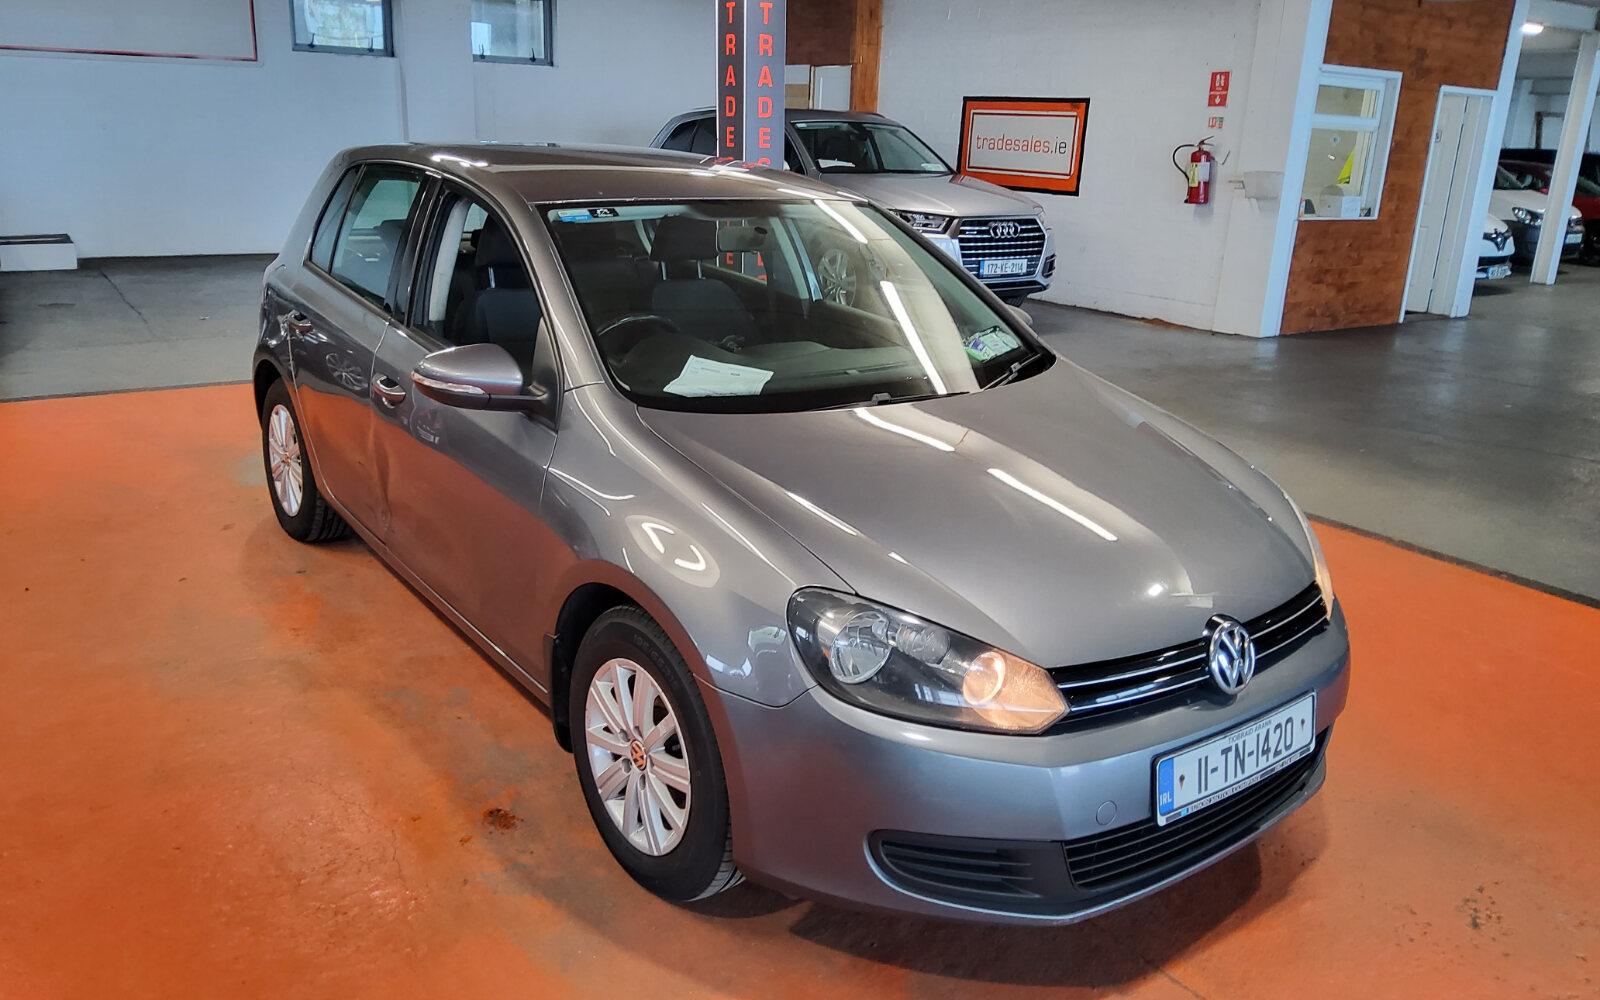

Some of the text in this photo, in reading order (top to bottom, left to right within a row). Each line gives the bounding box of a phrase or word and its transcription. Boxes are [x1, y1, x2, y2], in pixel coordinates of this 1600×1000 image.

[725, 1, 736, 161] TRADE
[976, 134, 1067, 155] tradesales.ie
[987, 262, 1024, 273] 172-KE-2114
[1197, 716, 1294, 795] 11-TN-1420
[1159, 792, 1172, 806] IRL
